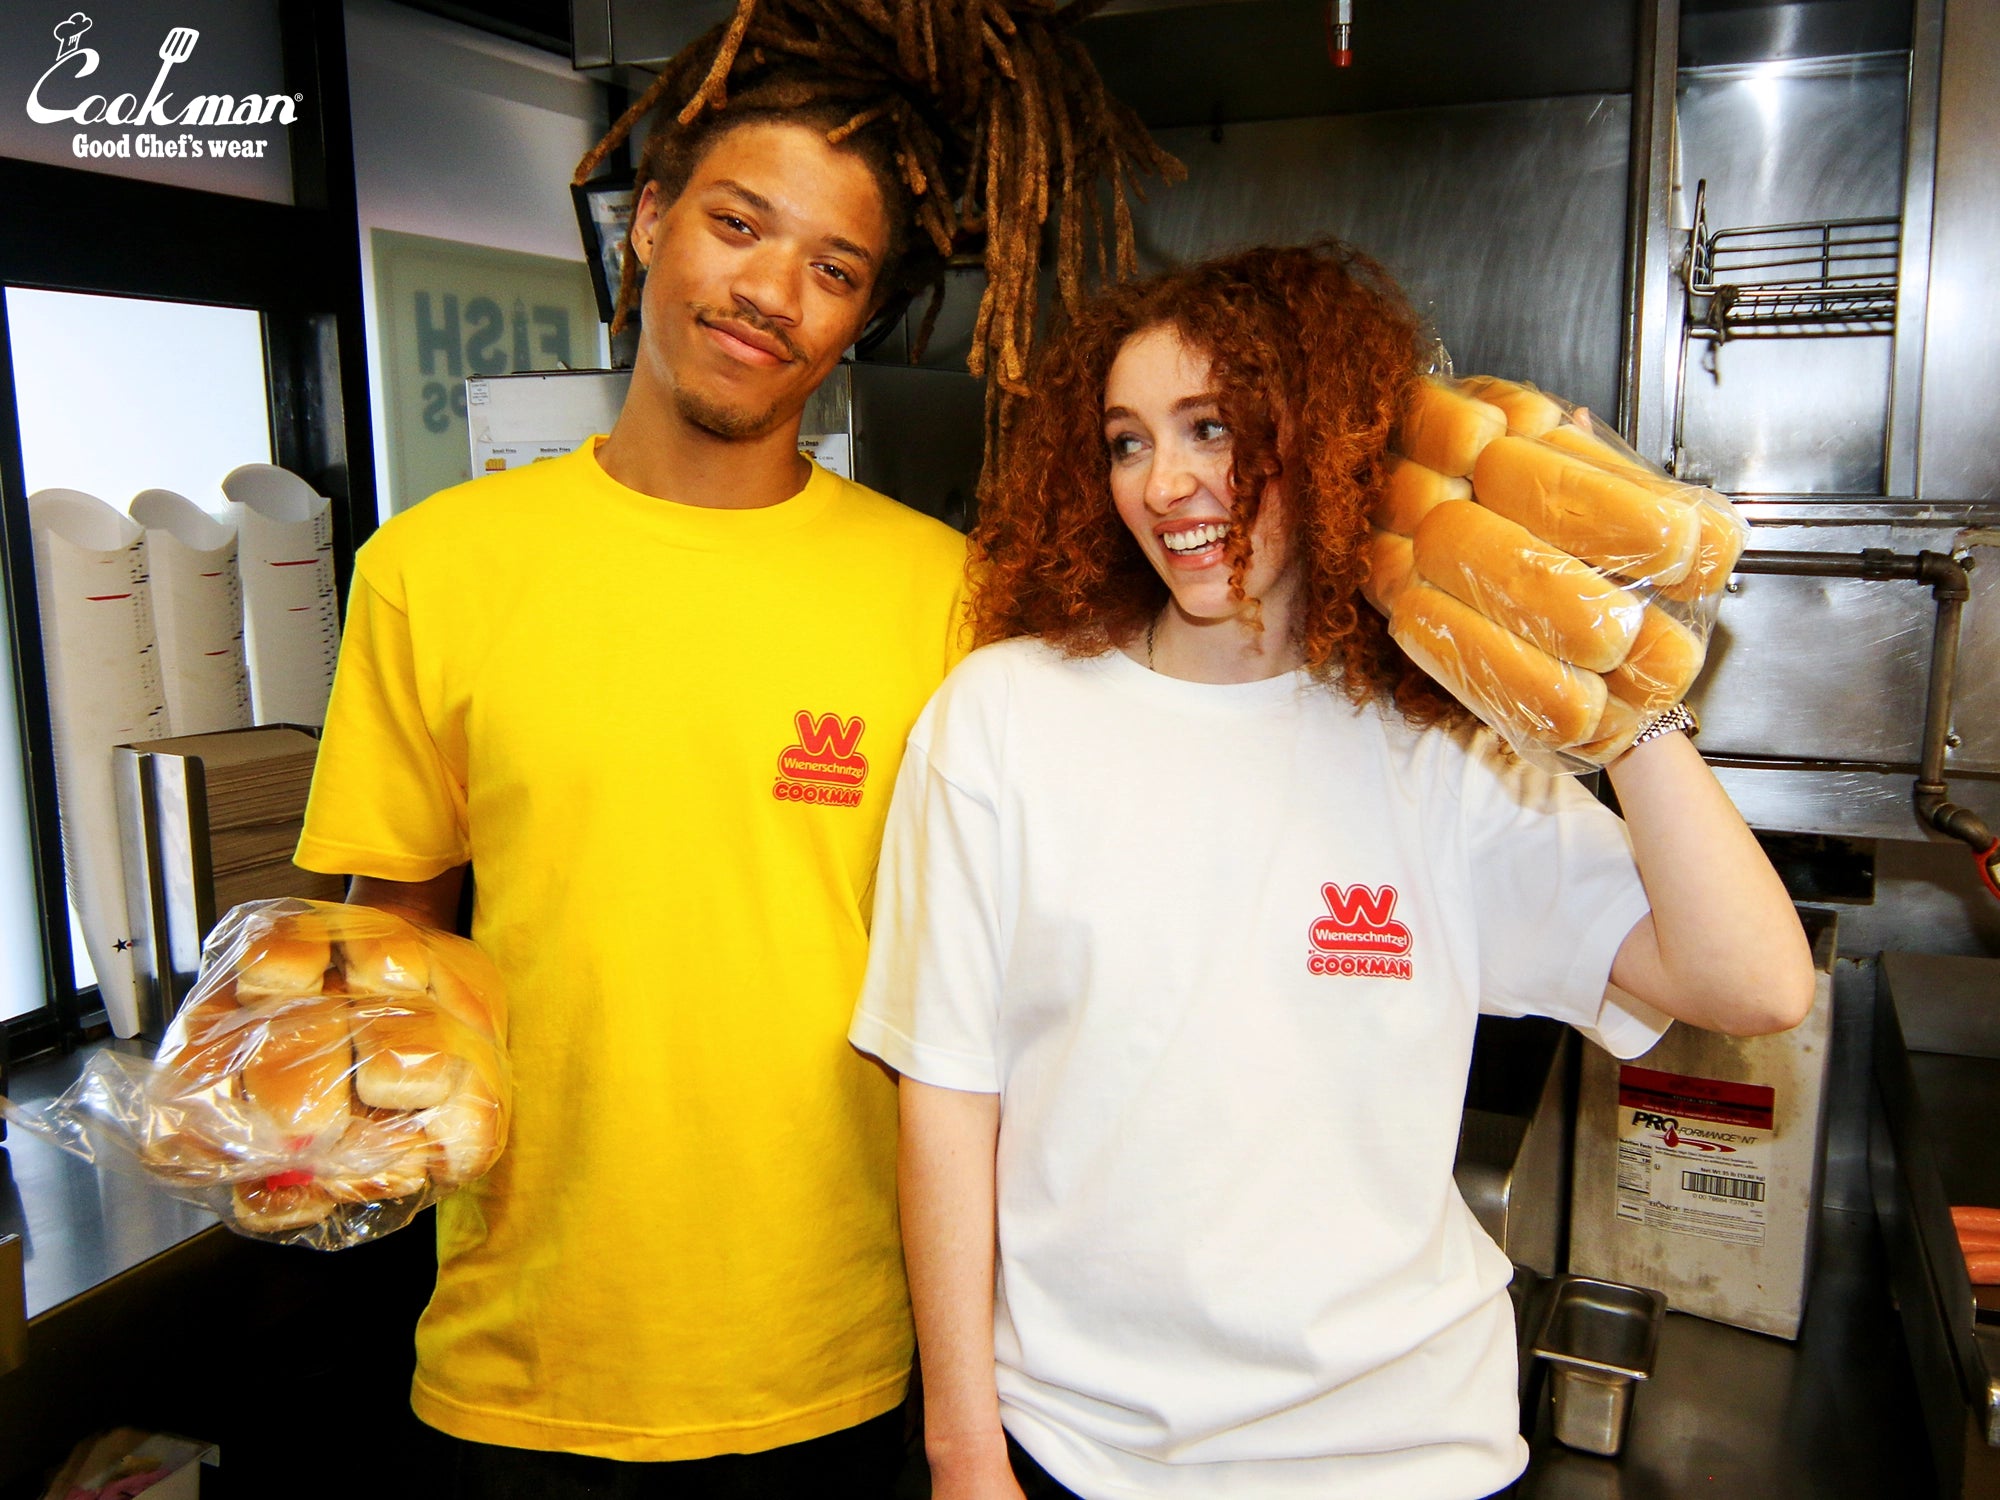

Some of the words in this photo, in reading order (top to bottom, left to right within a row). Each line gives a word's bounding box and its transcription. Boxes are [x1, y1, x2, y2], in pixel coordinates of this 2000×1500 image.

[783, 757, 865, 779] Wienerschnitzel
[772, 781, 863, 807] COOKMAN
[1315, 928, 1408, 947] Wienerschnitzel
[1307, 954, 1412, 980] COOKMAN
